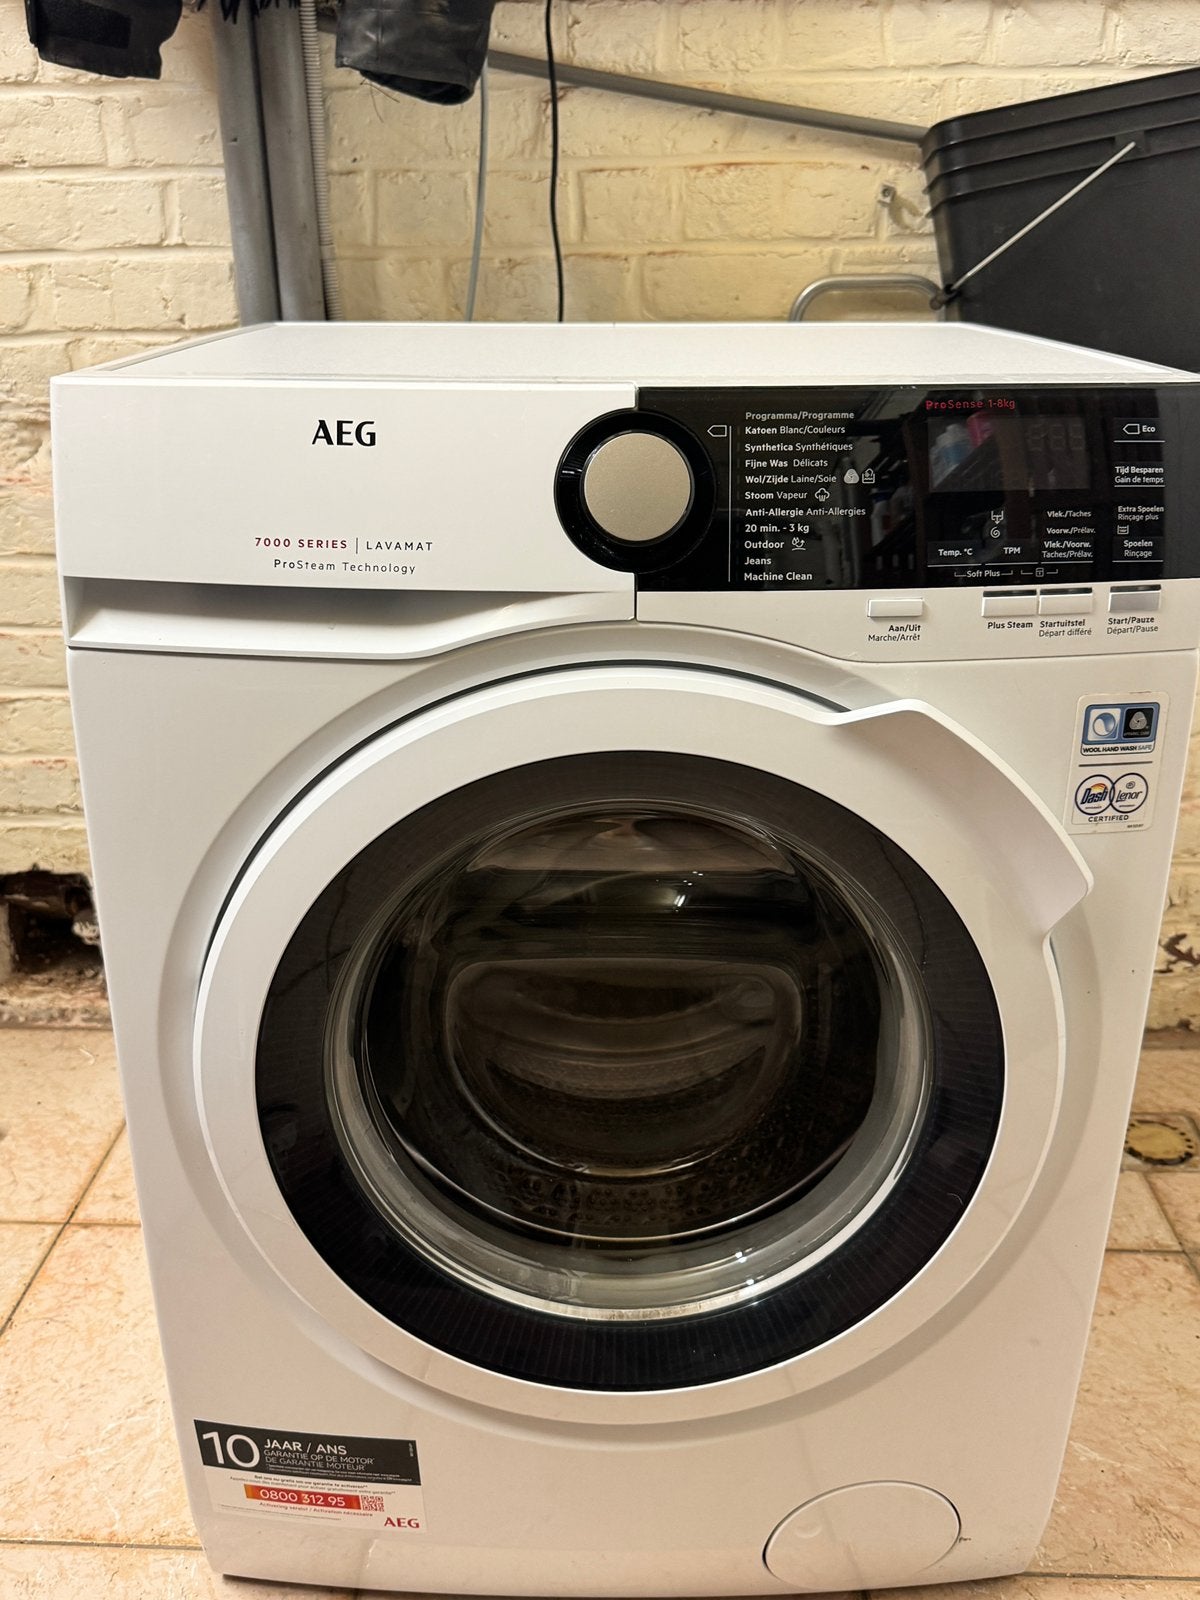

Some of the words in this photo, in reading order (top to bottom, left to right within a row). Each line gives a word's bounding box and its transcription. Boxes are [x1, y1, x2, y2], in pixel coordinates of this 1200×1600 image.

[926, 400, 983, 409] ProSense
[988, 399, 1015, 409] 1-8kg
[746, 412, 854, 421] Programma/Programme
[312, 420, 376, 446] AEG
[780, 426, 846, 434] Blanc/Couleurs
[1142, 425, 1156, 433] Eco
[745, 443, 793, 453] Synthetica
[796, 443, 853, 452] Synthétiques
[745, 460, 767, 470] Fijne
[1115, 466, 1129, 475] Tijd
[1131, 466, 1163, 475] Besparen
[745, 475, 788, 485] Wol/Zijde
[791, 474, 837, 483] Laine/Soie
[1143, 476, 1164, 484] temps
[777, 492, 807, 500] Vapeur
[746, 508, 803, 518] Anti-Allergie
[806, 508, 866, 517] Anti-Allergies
[1138, 506, 1164, 514] Spoelen
[1118, 513, 1146, 522] Rinçage
[1148, 513, 1158, 521] plus
[798, 524, 809, 533] kg
[1046, 527, 1096, 535] Voorw./Prélav.
[255, 538, 291, 547] 7000
[298, 539, 347, 549] SERIES
[366, 541, 433, 551] LAVAMAT
[744, 541, 784, 549] Outdoor
[1044, 540, 1091, 548] Vlek./Voorw.
[1124, 540, 1153, 548] Spoelen
[938, 548, 961, 557] Temp.
[1042, 550, 1093, 559] Taches/Prélav.
[1124, 549, 1152, 558] Rinçage
[274, 559, 335, 570] ProSteam
[342, 562, 415, 574] Technology
[1040, 619, 1085, 628] Startuitstel
[1108, 616, 1154, 625] Start/Pauze
[1039, 629, 1065, 637] Départ
[1067, 628, 1092, 636] différé
[1107, 625, 1158, 634] Départ/Pause
[1080, 787, 1108, 805] Dash
[1116, 790, 1142, 802] Lenor
[202, 1431, 260, 1468] 10
[264, 1439, 302, 1451] JAAR
[316, 1444, 347, 1455] ANS
[264, 1450, 308, 1460] GARANTIE
[280, 1458, 324, 1468] GARANTIE
[260, 1489, 298, 1502] 0800
[301, 1493, 324, 1505] 312
[328, 1496, 345, 1506] 95
[384, 1517, 420, 1528] AEG
